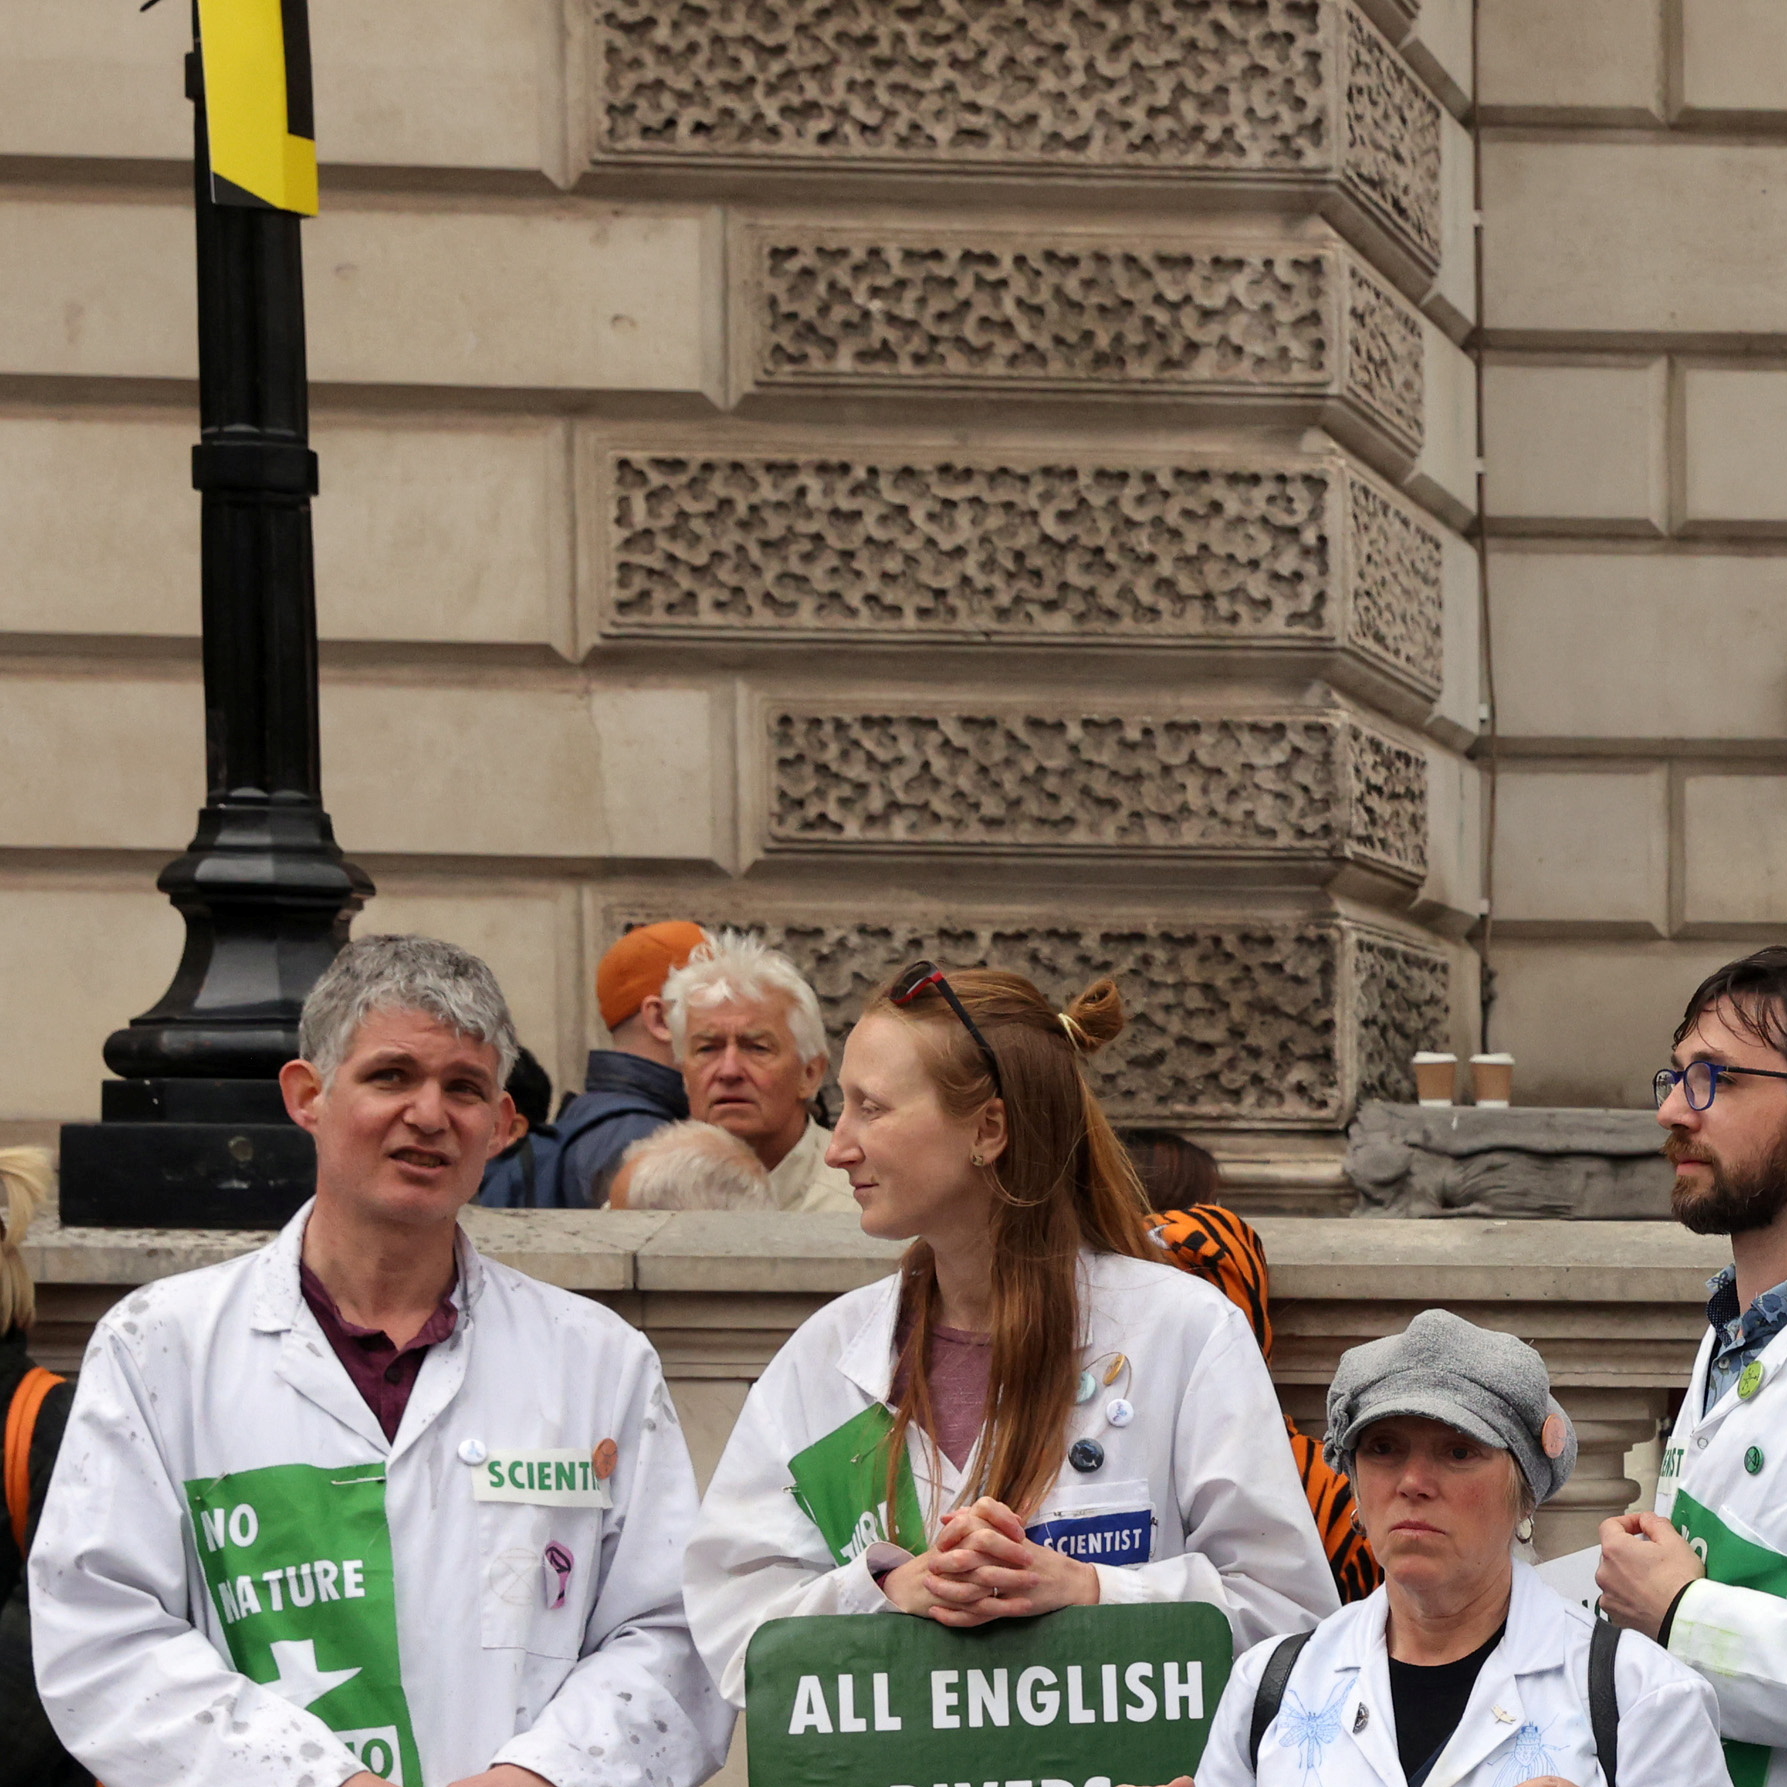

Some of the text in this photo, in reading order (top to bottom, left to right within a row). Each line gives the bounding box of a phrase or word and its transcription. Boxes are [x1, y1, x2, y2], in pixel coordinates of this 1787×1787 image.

[202, 1504, 258, 1550] NO
[220, 1559, 365, 1621] NATURE
[789, 1661, 1203, 1734] ALL ENGLISH
